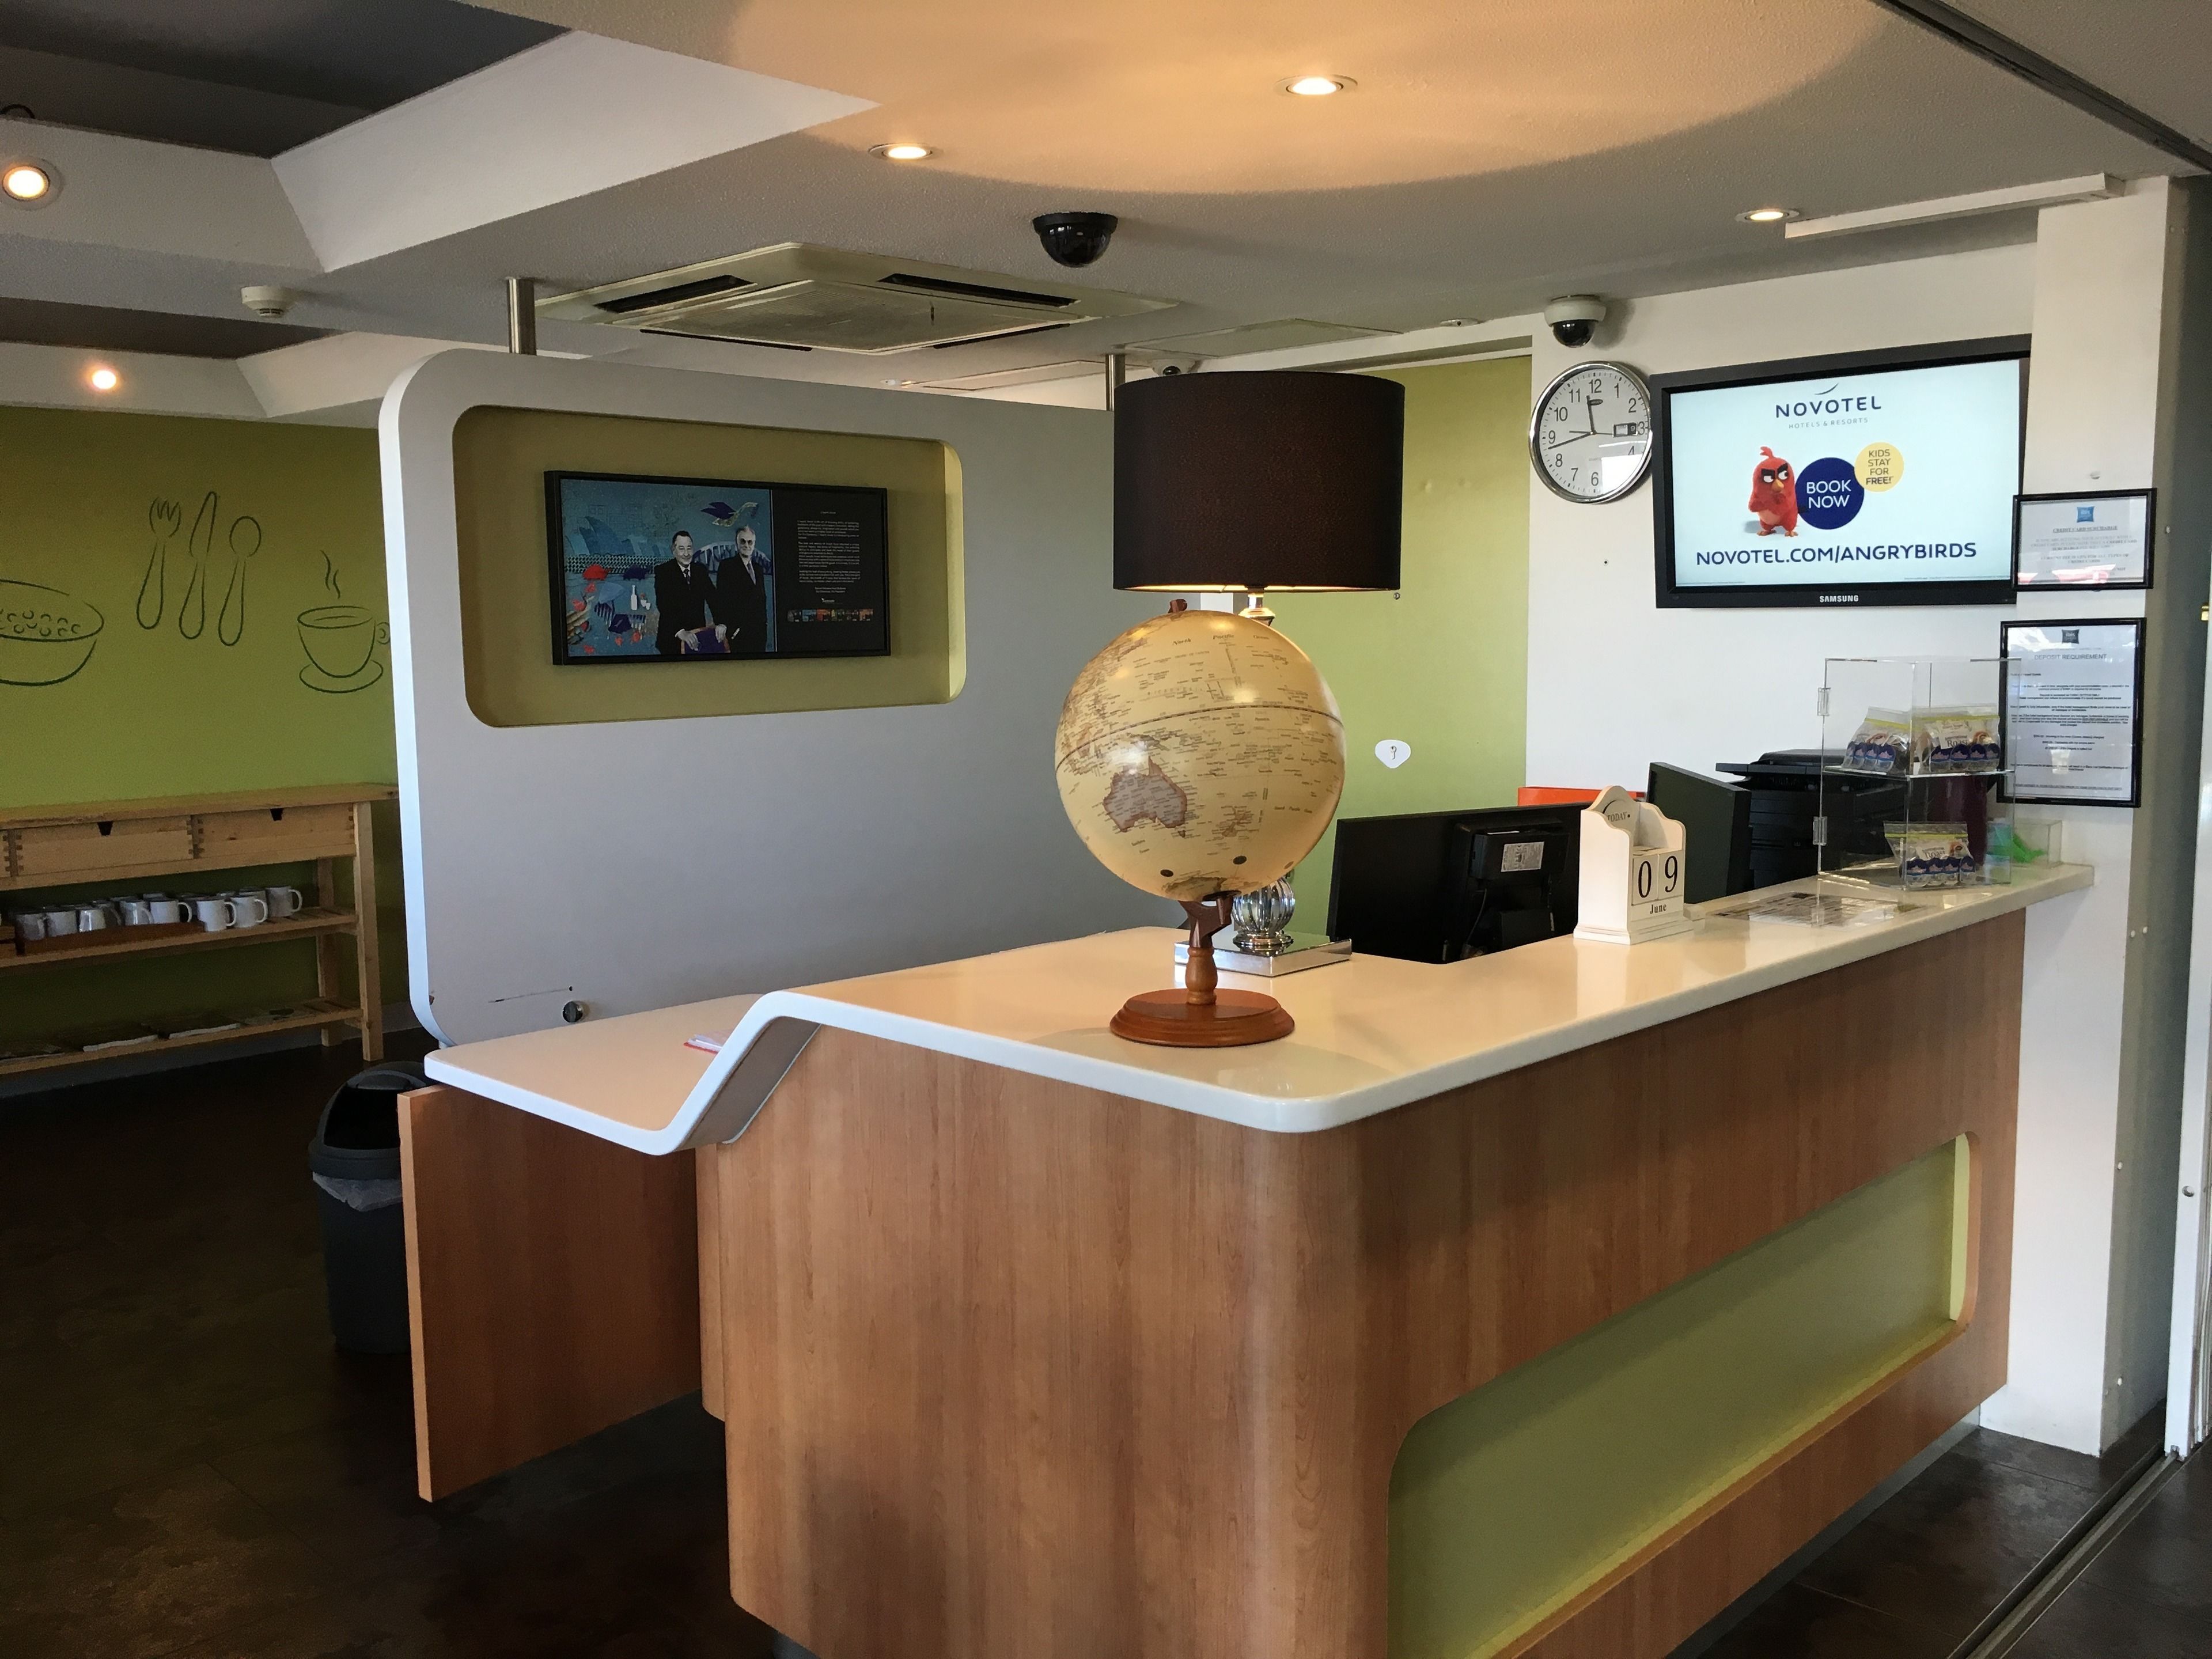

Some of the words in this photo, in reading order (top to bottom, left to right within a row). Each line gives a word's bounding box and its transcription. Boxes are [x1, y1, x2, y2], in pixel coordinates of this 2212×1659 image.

[1589, 378, 1602, 393] 12
[1614, 383, 1619, 398] 1
[1569, 388, 1581, 403] 11
[1628, 397, 1637, 413] 2
[1775, 396, 1881, 418] NOVOTEL
[1554, 407, 1568, 421] 10
[1637, 421, 1645, 435] 3
[1831, 417, 1868, 426] RESORTS
[1548, 430, 1555, 444] 9
[1555, 453, 1563, 467] 8
[1868, 449, 1891, 457] KIDS
[1868, 458, 1891, 467] STAY
[1571, 468, 1578, 481] 7
[1869, 467, 1889, 476] FOR
[1591, 472, 1599, 486] 6
[1866, 476, 1893, 486] FREE!
[1806, 479, 1851, 494] BOOK
[1808, 494, 1850, 509] NOW
[1696, 543, 1977, 566] NOVOTEL.COM/ANGRYBIRDS
[1819, 594, 1859, 603] SAMSUNG
[1607, 812, 1627, 823] TODAY
[1649, 904, 1667, 915] June
